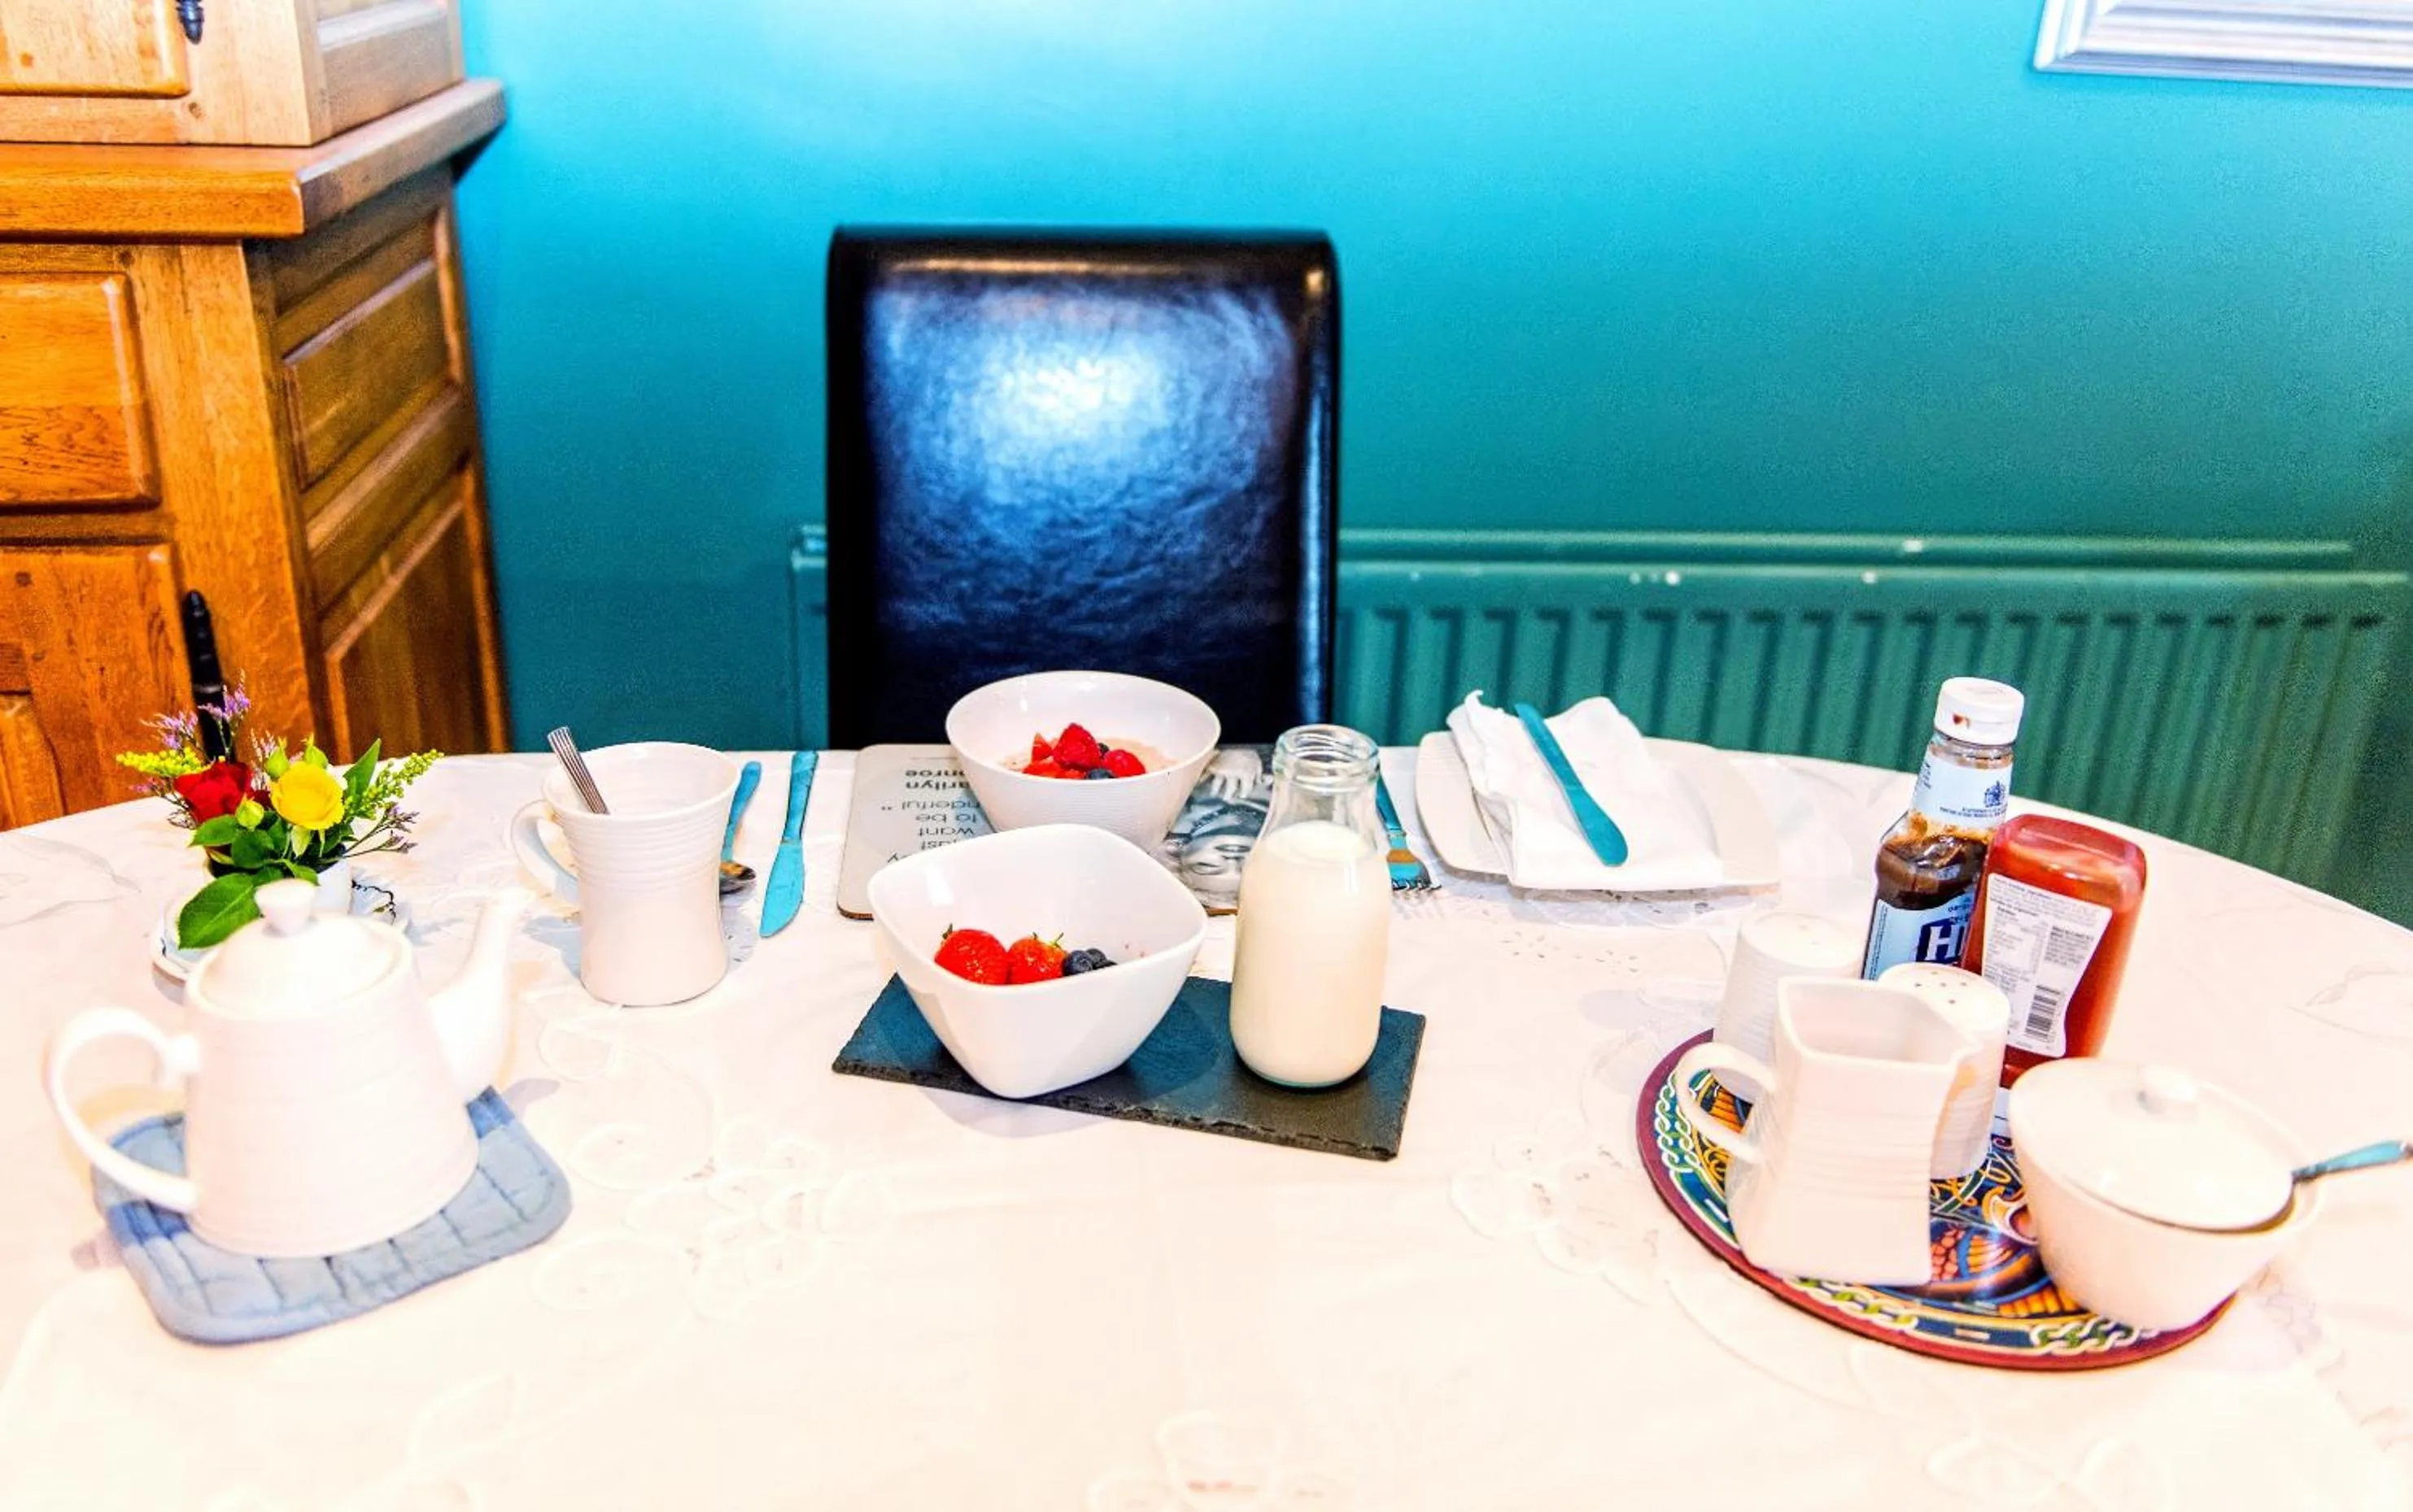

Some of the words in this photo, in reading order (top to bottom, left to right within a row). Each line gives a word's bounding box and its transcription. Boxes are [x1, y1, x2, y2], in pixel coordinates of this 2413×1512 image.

[905, 780, 970, 791] arilyn
[902, 800, 980, 811] nderful
[915, 814, 947, 823] be
[955, 814, 976, 823] to
[918, 827, 974, 837] want
[921, 839, 957, 851] ust
[1925, 925, 1962, 961] H
